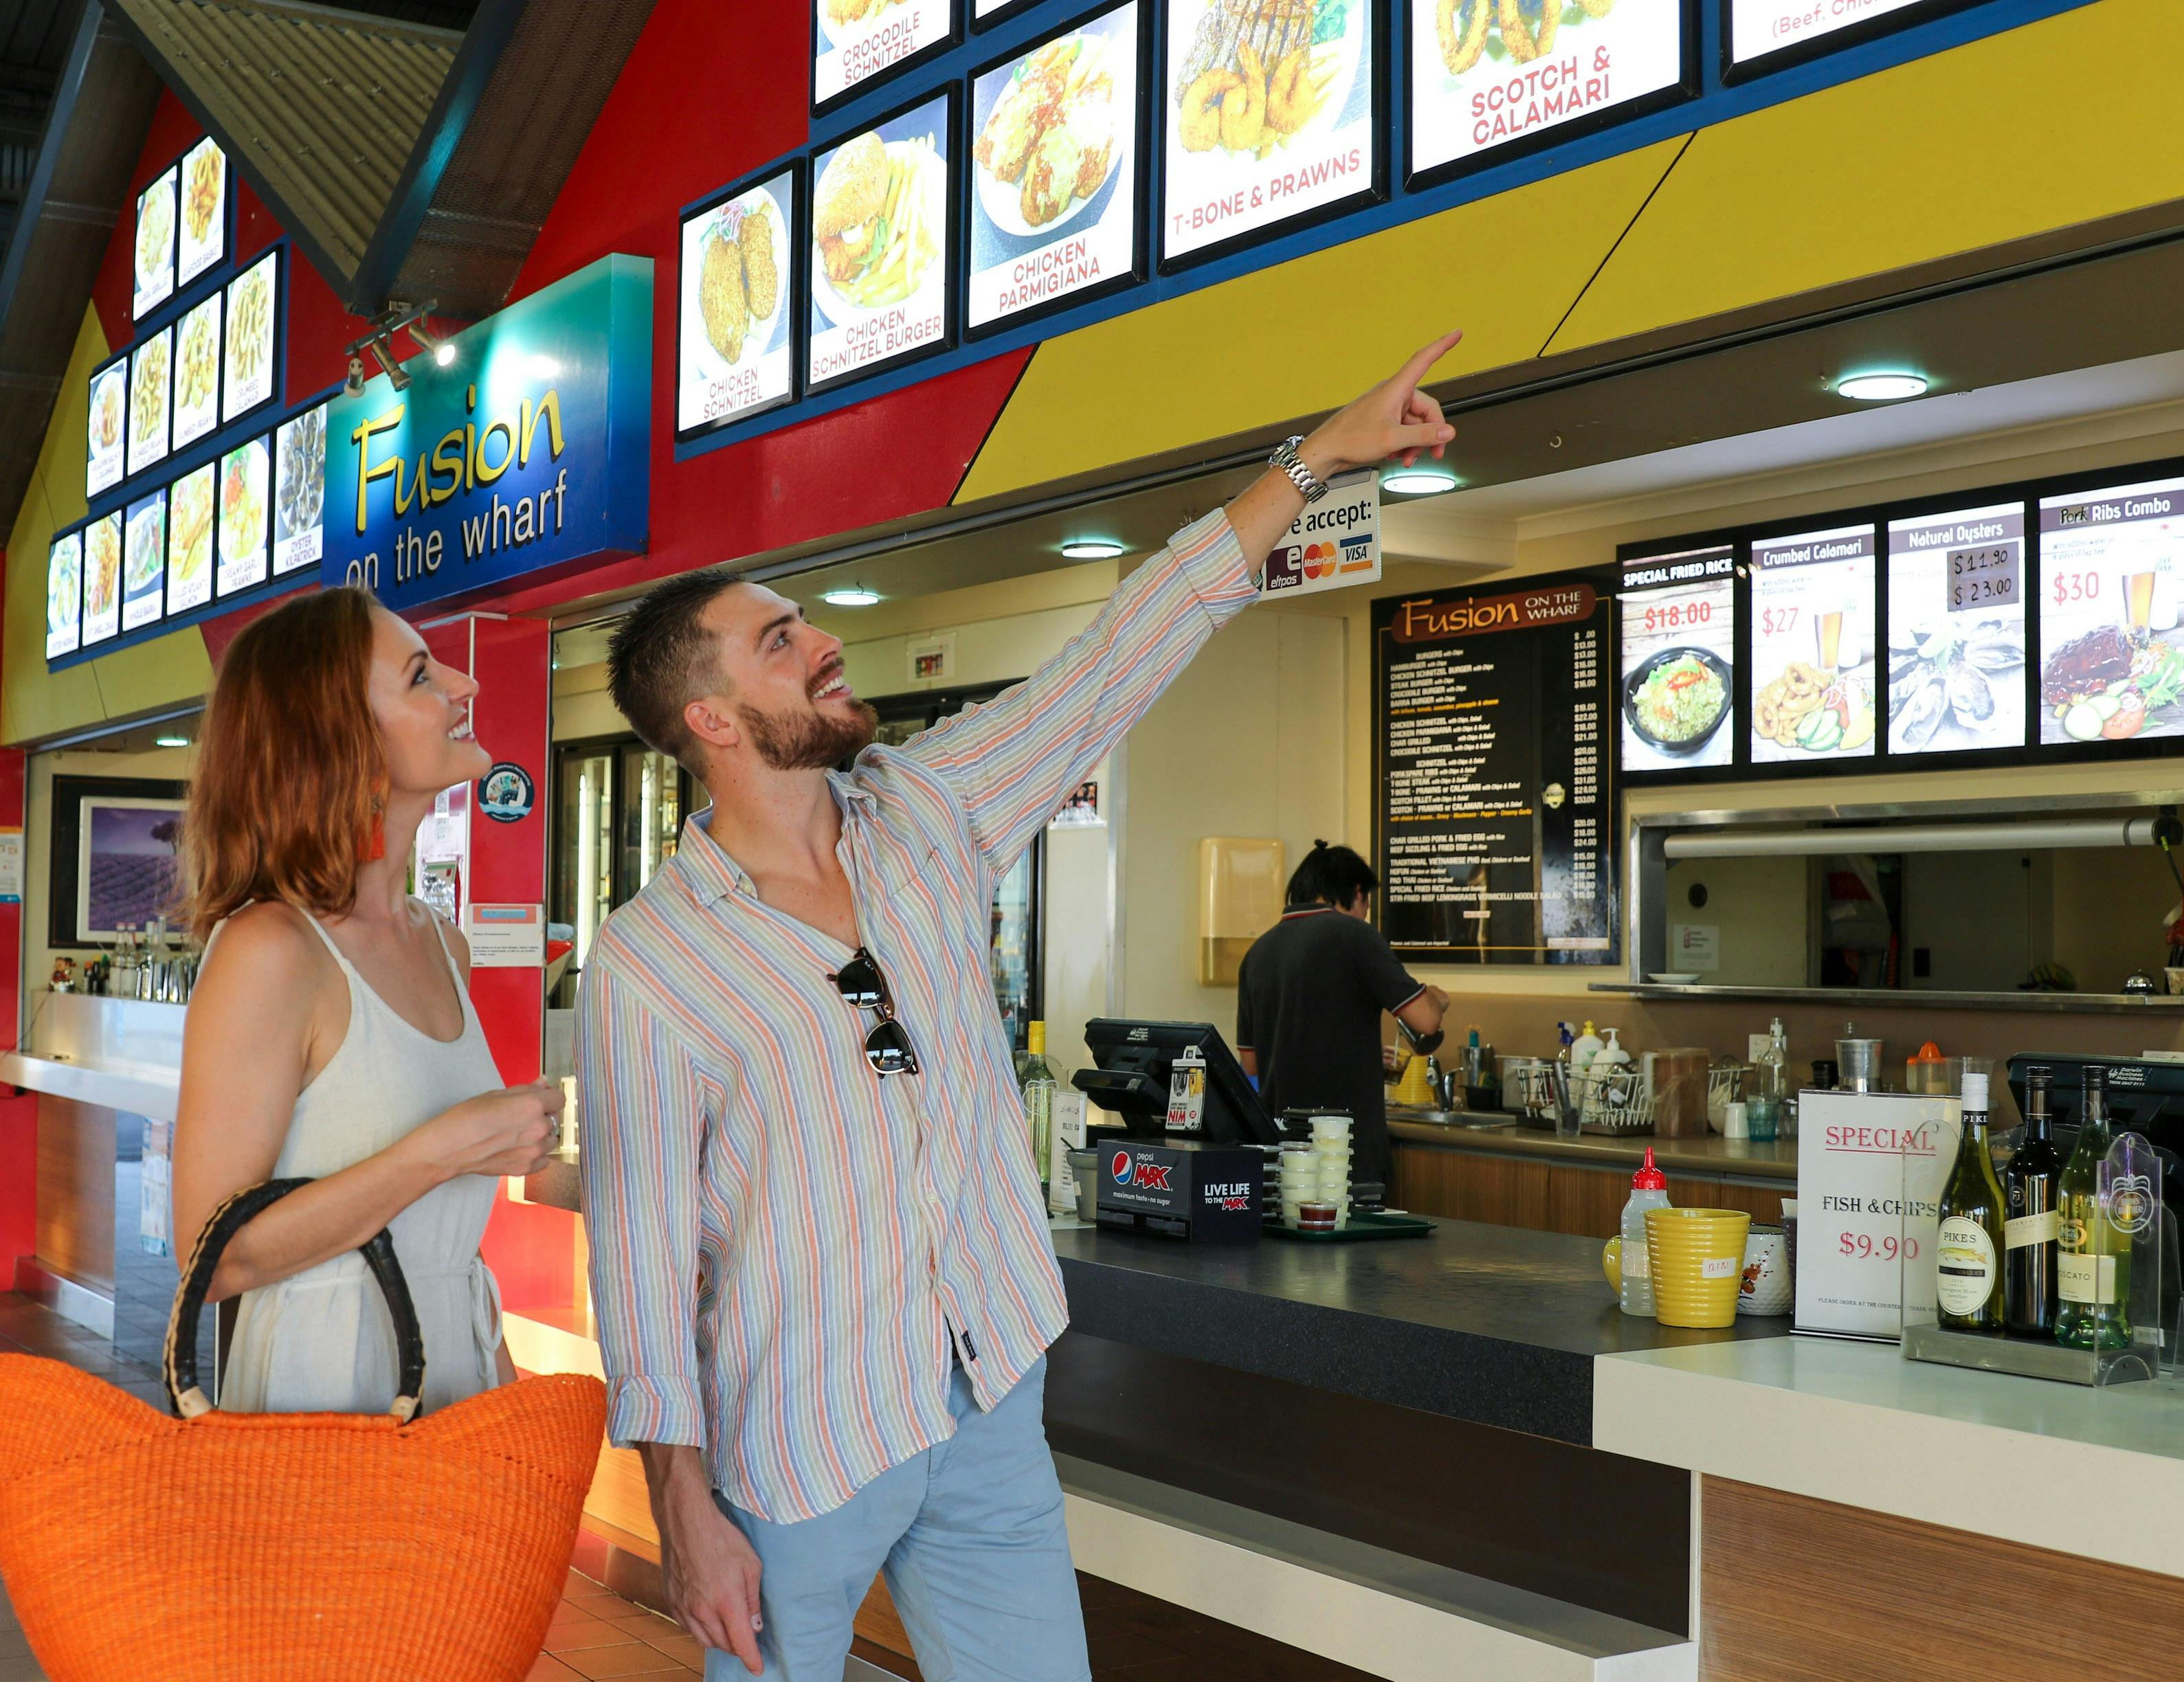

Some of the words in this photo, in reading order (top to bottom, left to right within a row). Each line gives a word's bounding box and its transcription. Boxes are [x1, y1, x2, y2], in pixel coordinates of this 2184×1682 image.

[843, 12, 920, 66] CROCODILE
[845, 34, 917, 86] SCHNITZEL
[1471, 55, 1577, 118] SCOTCH
[1592, 45, 1612, 71] &
[1473, 74, 1610, 145] CALAMARI
[1173, 191, 1245, 234] T-BONE
[1250, 186, 1263, 208] &
[1270, 148, 1360, 201] PRAWNS
[1014, 238, 1086, 284] CHICKEN
[999, 257, 1100, 312] PARMIGIANA
[847, 307, 906, 344] CHICKEN
[813, 340, 882, 377] SCHNITZEL
[886, 316, 941, 351] BURGER
[709, 367, 758, 399] CHICKEN
[704, 385, 763, 419] SCHNITZEL
[352, 383, 565, 532] Fusion
[1291, 517, 1301, 535] e
[1306, 500, 1371, 532] accept:
[2060, 507, 2088, 524] Pork
[2092, 504, 2121, 522] Ribs
[2124, 497, 2171, 517] Combo
[291, 535, 311, 553] OYSTER
[346, 551, 379, 591] on
[396, 526, 443, 582] the
[463, 468, 567, 558] wharf
[1909, 526, 1953, 548] Natural
[1957, 522, 2003, 541] Oysters
[285, 546, 316, 567] KILPATRICK
[1304, 554, 1336, 568] MasterCard
[1346, 546, 1368, 561] VISA
[1763, 545, 1811, 566] Crumbed
[1813, 539, 1862, 559] Calamari
[1271, 575, 1297, 589] eftpos
[1623, 566, 1669, 587] SPECIAL
[1670, 563, 1705, 580] FRIED
[1706, 558, 1733, 574] RICE
[1525, 596, 1550, 608] ON
[1554, 591, 1581, 604] THE
[2053, 571, 2099, 606] $30
[1401, 597, 1519, 636] Fusion
[1527, 603, 1580, 620] WHARF
[1645, 601, 1711, 630] $18.00
[1762, 606, 1799, 637] $27
[1825, 1125, 1936, 1150] SPECIAL
[1137, 1153, 1154, 1162] pepsi
[1133, 1163, 1172, 1191] MAX
[1205, 1184, 1227, 1196] LIVE
[1230, 1183, 1249, 1195] LIFE
[1222, 1196, 1249, 1211] MAX
[1823, 1196, 1861, 1212] FISH
[1868, 1198, 1881, 1213] &
[1883, 1200, 1937, 1217] CHIPS
[1839, 1231, 1920, 1261] $9.90
[1944, 1232, 1976, 1243] PIKES
[2059, 1270, 2090, 1280] OSCATO
